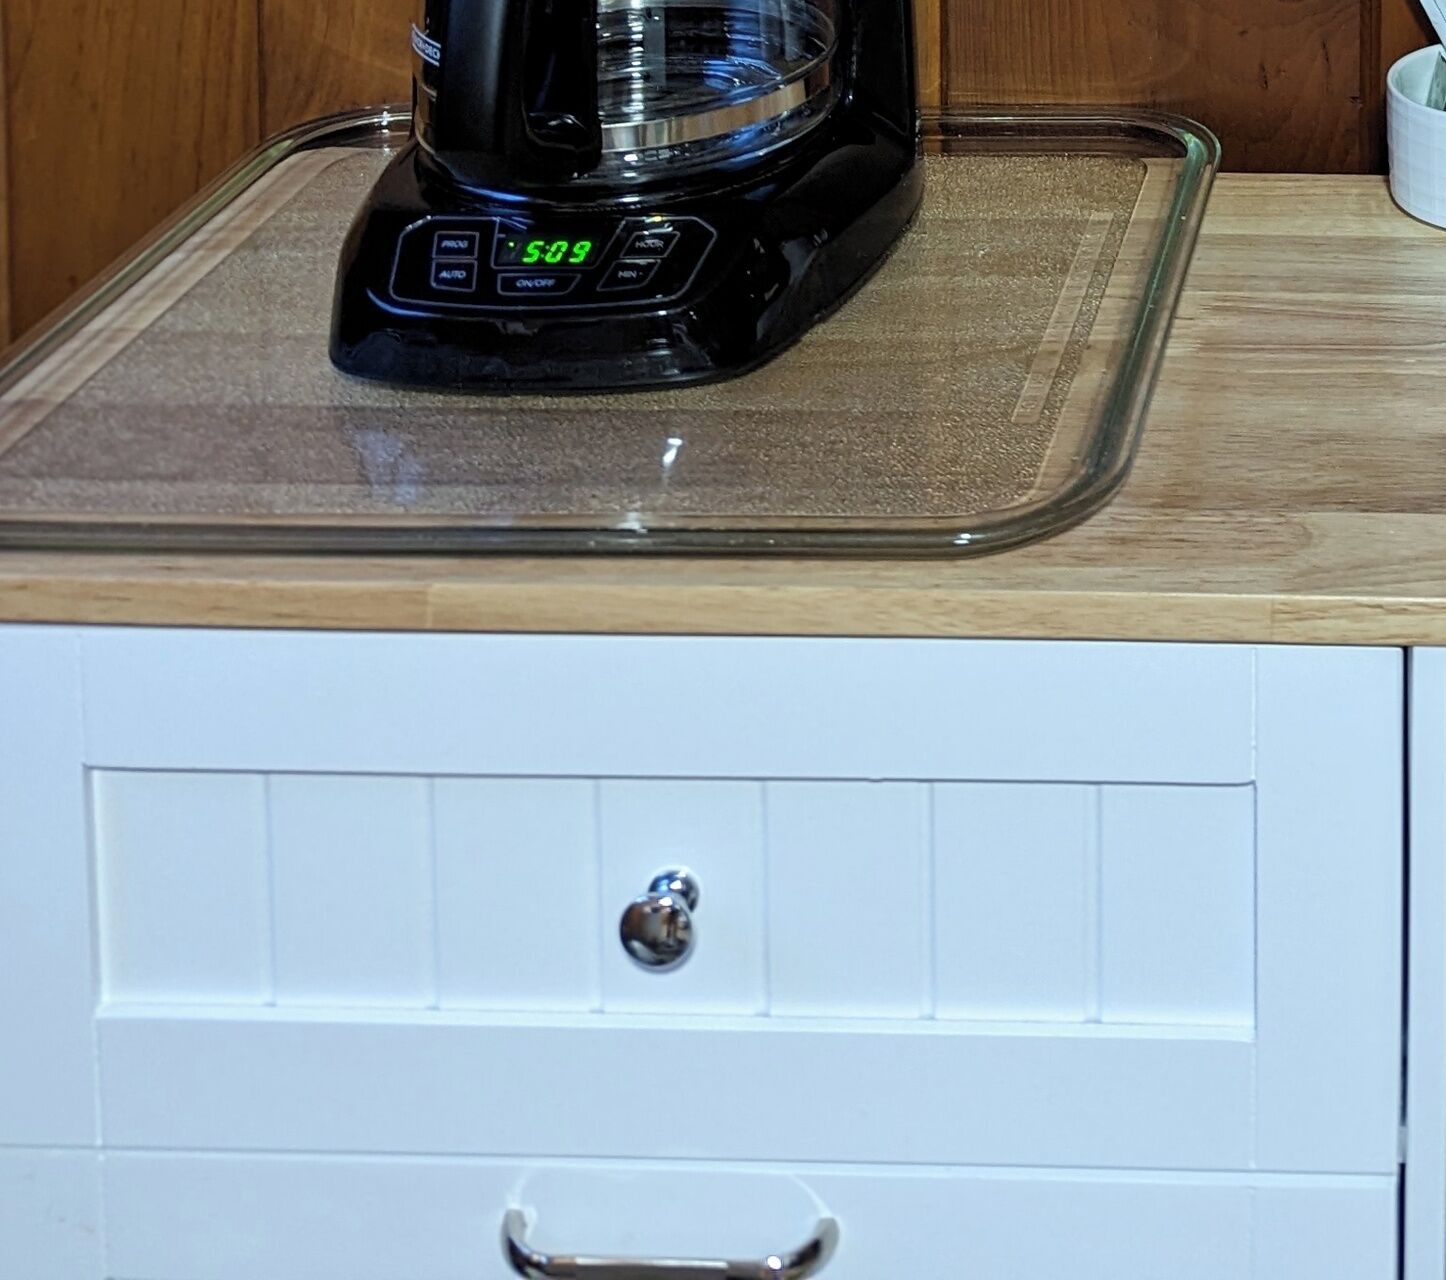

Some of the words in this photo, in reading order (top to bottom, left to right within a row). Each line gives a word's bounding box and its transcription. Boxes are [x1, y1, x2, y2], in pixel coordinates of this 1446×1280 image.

[441, 239, 468, 249] PROG
[635, 239, 664, 249] HOUR
[522, 241, 592, 263] 5:09
[438, 270, 467, 279] AUTO
[617, 269, 637, 278] MIN
[515, 278, 556, 288] ON/OFF
